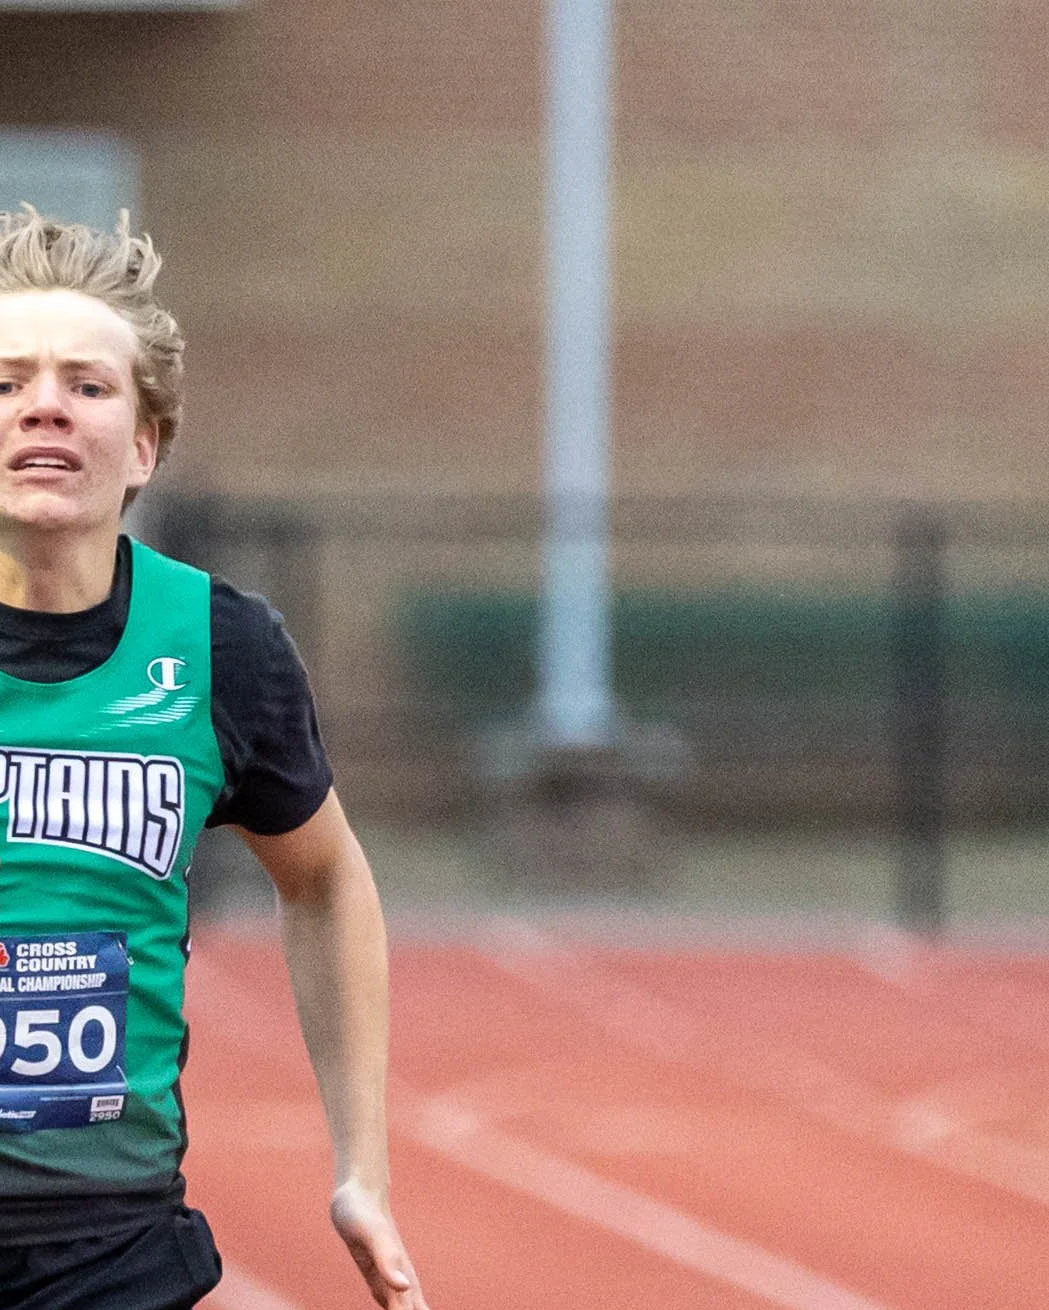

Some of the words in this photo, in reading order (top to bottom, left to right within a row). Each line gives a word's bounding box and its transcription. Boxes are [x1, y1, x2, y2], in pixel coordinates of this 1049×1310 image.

[16, 941, 78, 957] CROSS
[16, 955, 97, 972] COUNTRY
[17, 973, 107, 992] CHAMPIONSHIP
[89, 1110, 121, 1123] 2950
